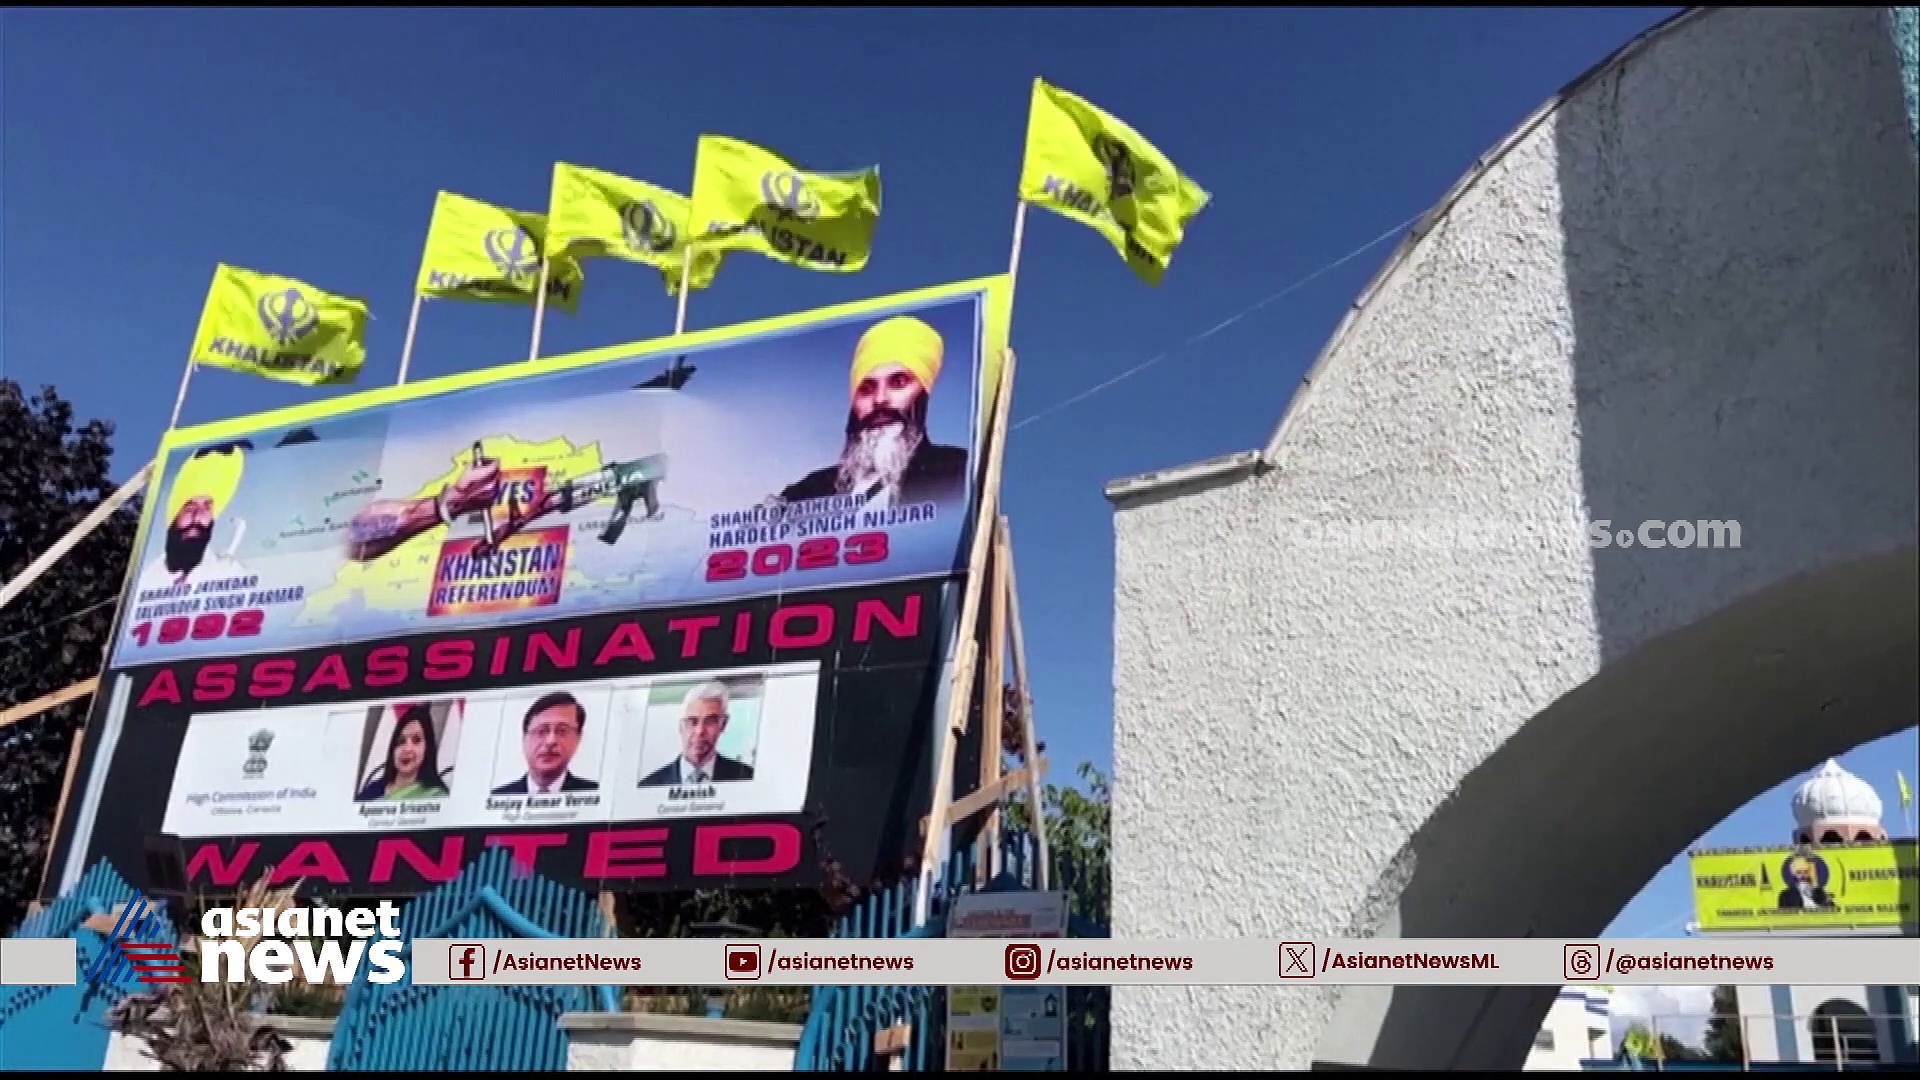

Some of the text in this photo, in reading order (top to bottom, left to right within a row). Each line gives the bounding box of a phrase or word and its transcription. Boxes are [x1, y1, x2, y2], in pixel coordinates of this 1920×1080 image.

[494, 480, 537, 505] YES
[709, 503, 936, 548] HARDEEP SINGH NIJJAR
[440, 544, 561, 583] KHALISTAN
[706, 531, 889, 583] 2023
[434, 577, 555, 605] REFERENDUM
[131, 608, 265, 647] 1992
[136, 594, 922, 707] ASSASSINATION
[668, 786, 717, 800] Manish
[187, 823, 803, 887] WANTED
